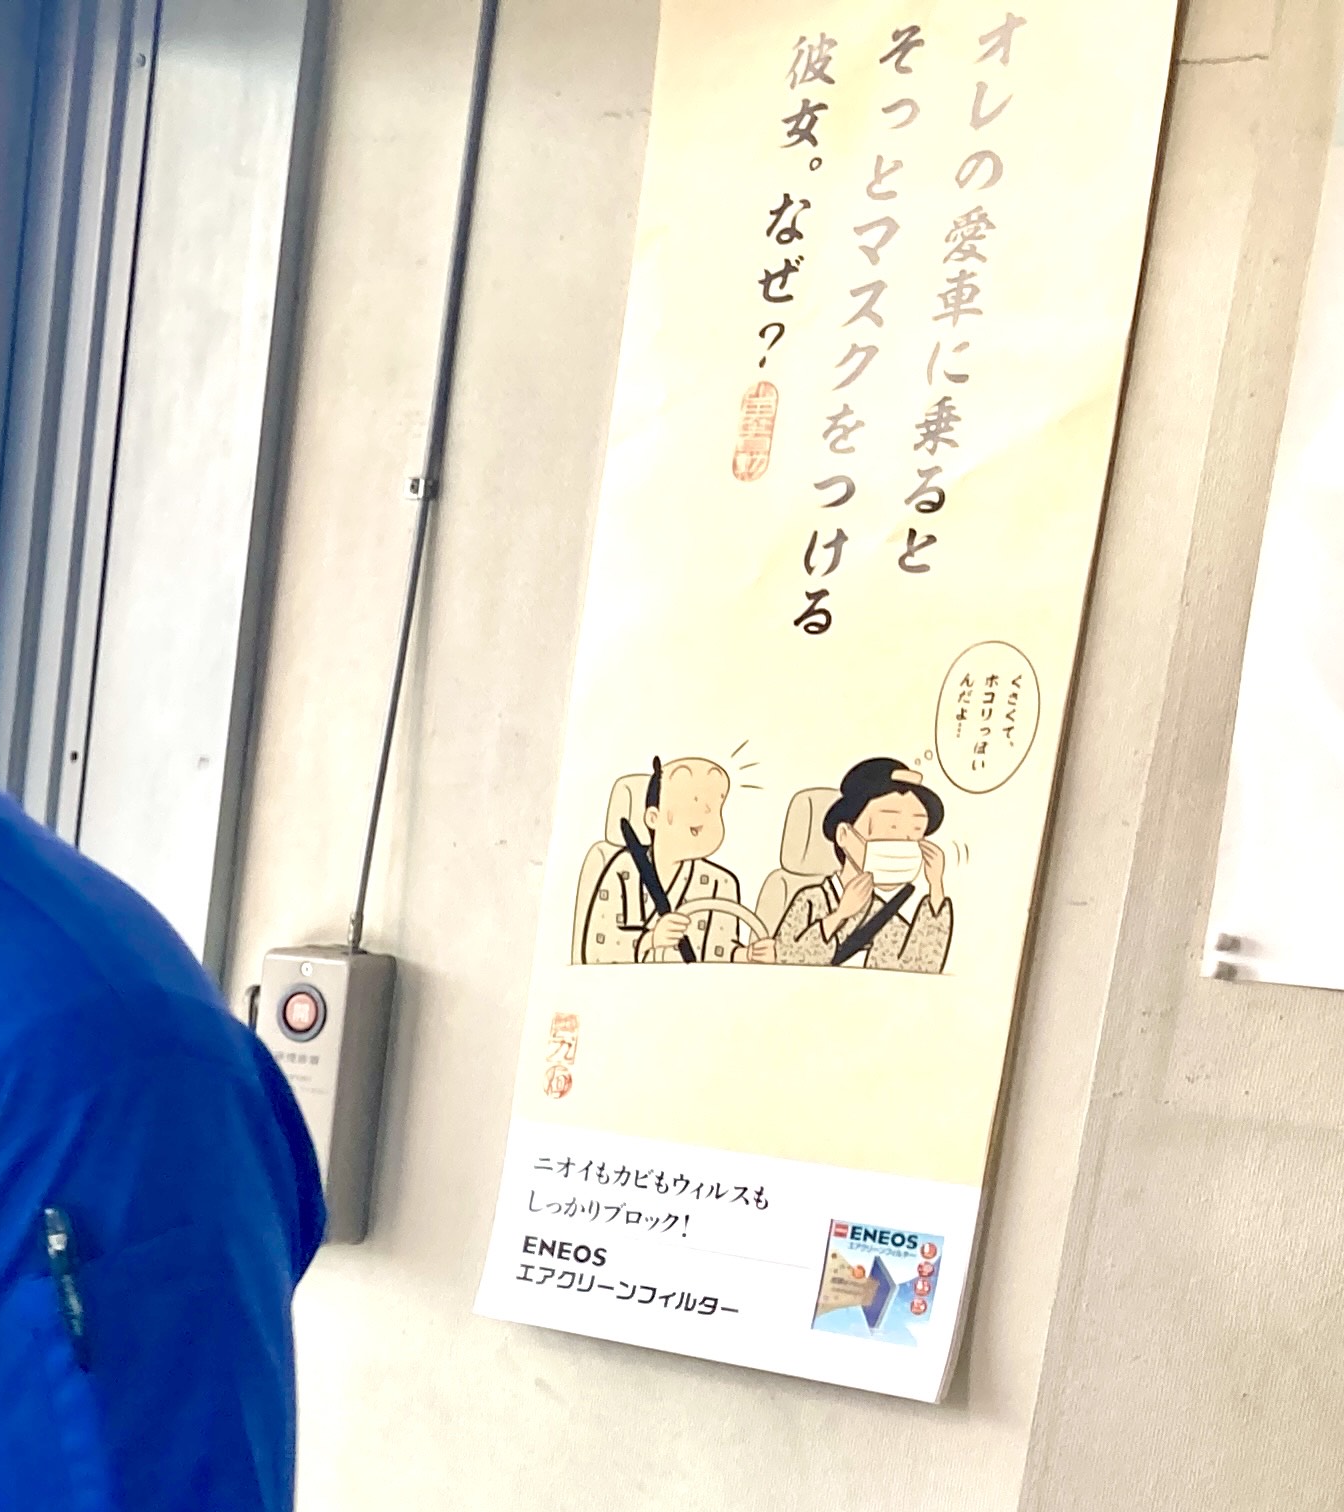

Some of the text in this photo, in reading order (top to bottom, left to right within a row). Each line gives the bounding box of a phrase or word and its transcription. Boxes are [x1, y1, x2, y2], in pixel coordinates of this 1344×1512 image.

[757, 34, 839, 368] 彼女。なぜ？
[897, 12, 1028, 574] オレの愛車に乗ると
[793, 25, 925, 635] そっとマスクをつける
[533, 1155, 770, 1211] ニオイもカビもウィルスも
[528, 1190, 690, 1239] しっかりブロック！
[850, 1225, 919, 1250] ENEOS
[522, 1236, 608, 1267] ENEOS
[516, 1264, 740, 1317] エアクリーンフィルター
